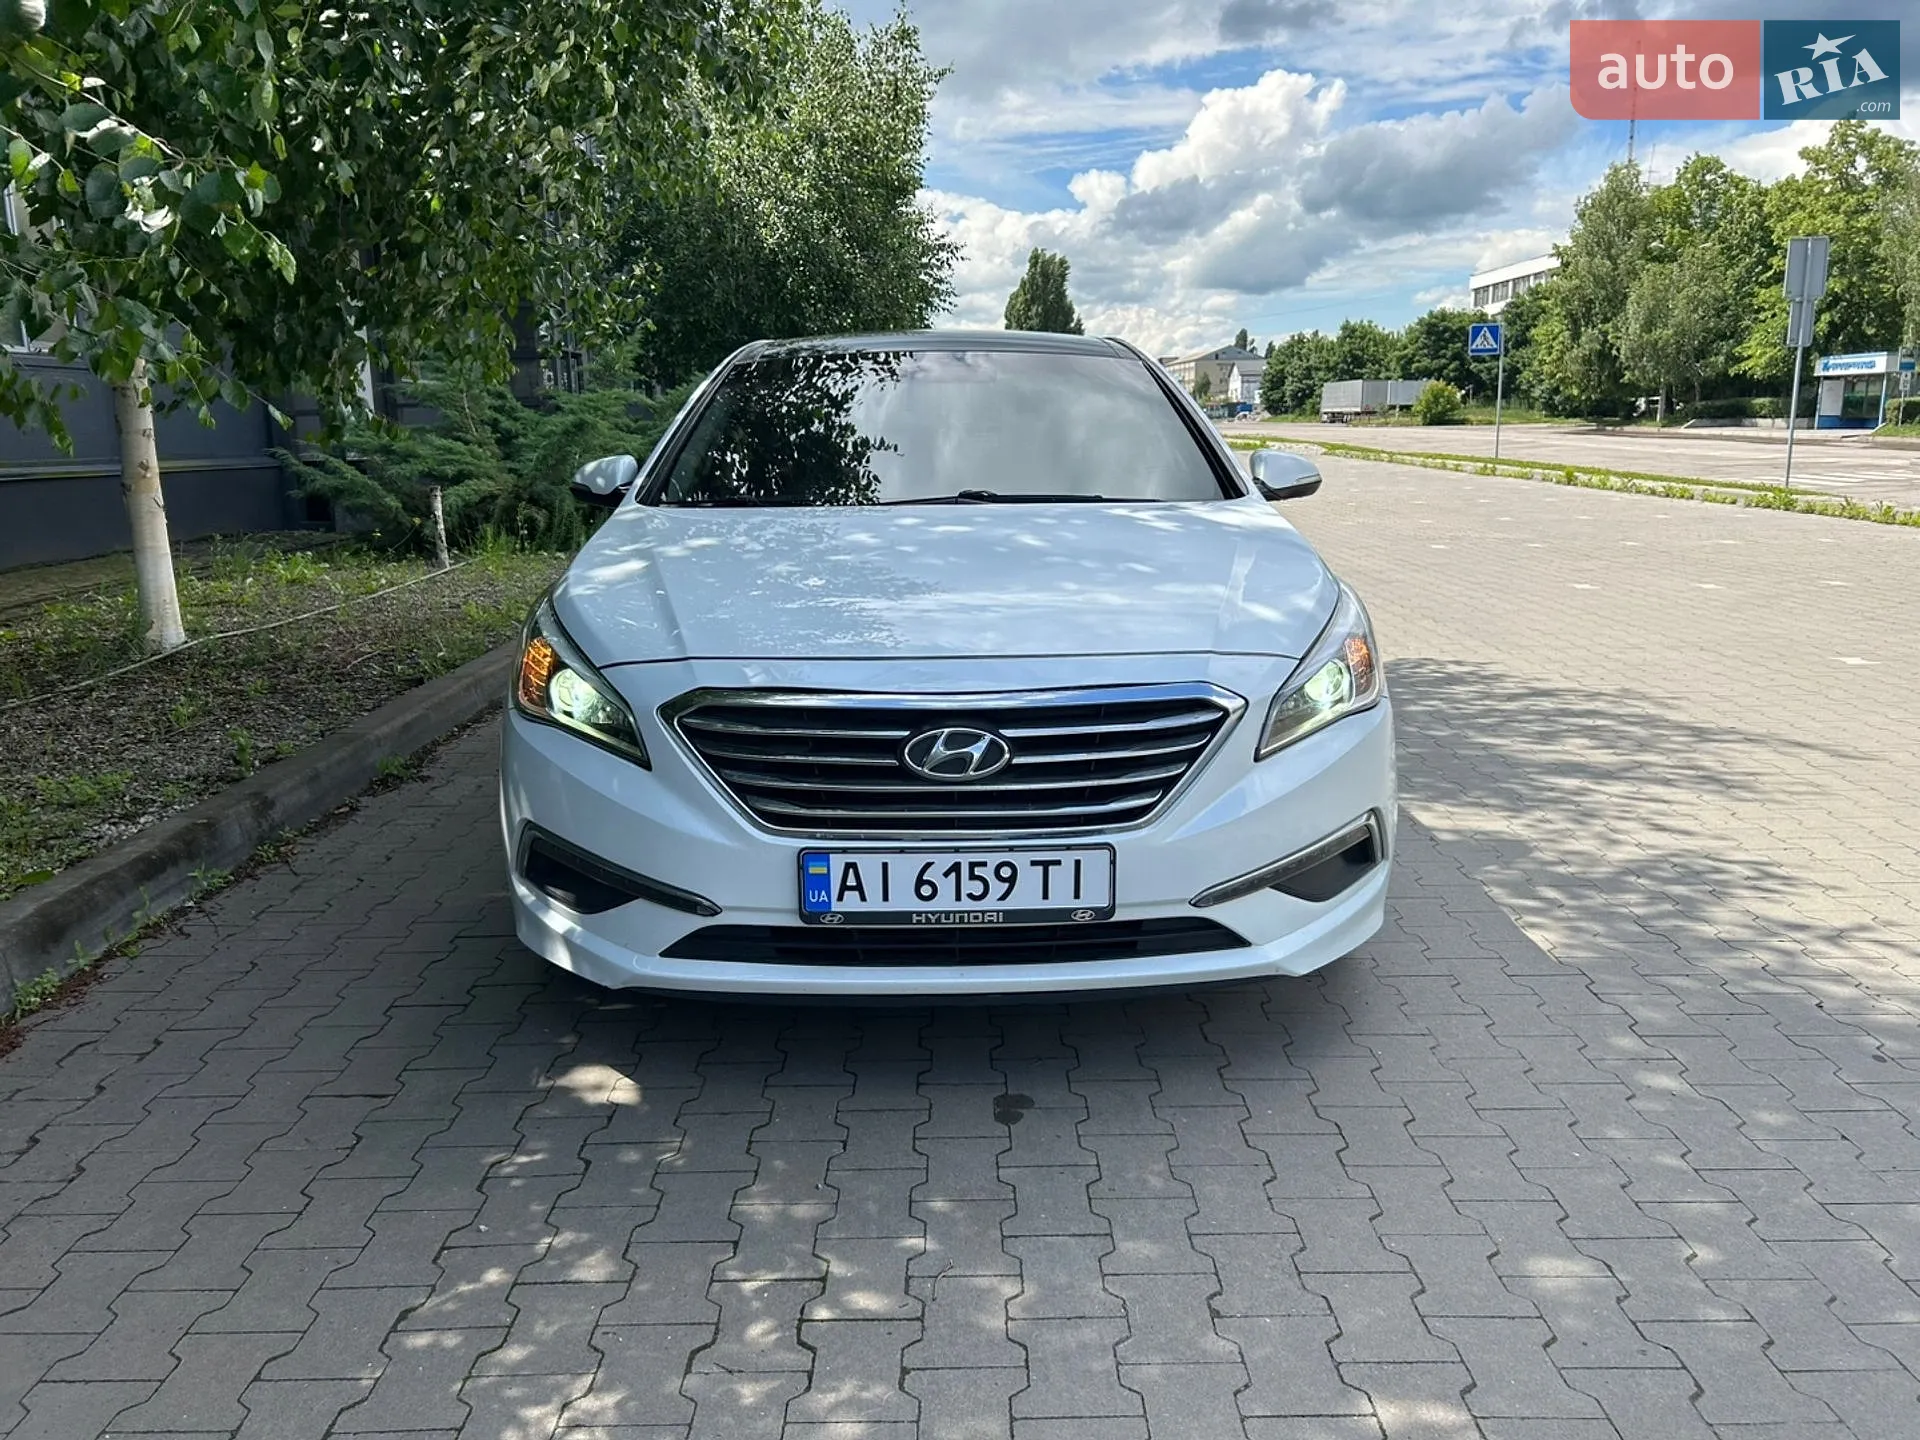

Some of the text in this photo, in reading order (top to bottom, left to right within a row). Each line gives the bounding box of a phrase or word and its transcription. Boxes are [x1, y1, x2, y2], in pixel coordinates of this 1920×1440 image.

[836, 859, 1082, 902] AI 6159 TI
[809, 889, 828, 903] UA
[912, 911, 1004, 923] HYUNDAI
